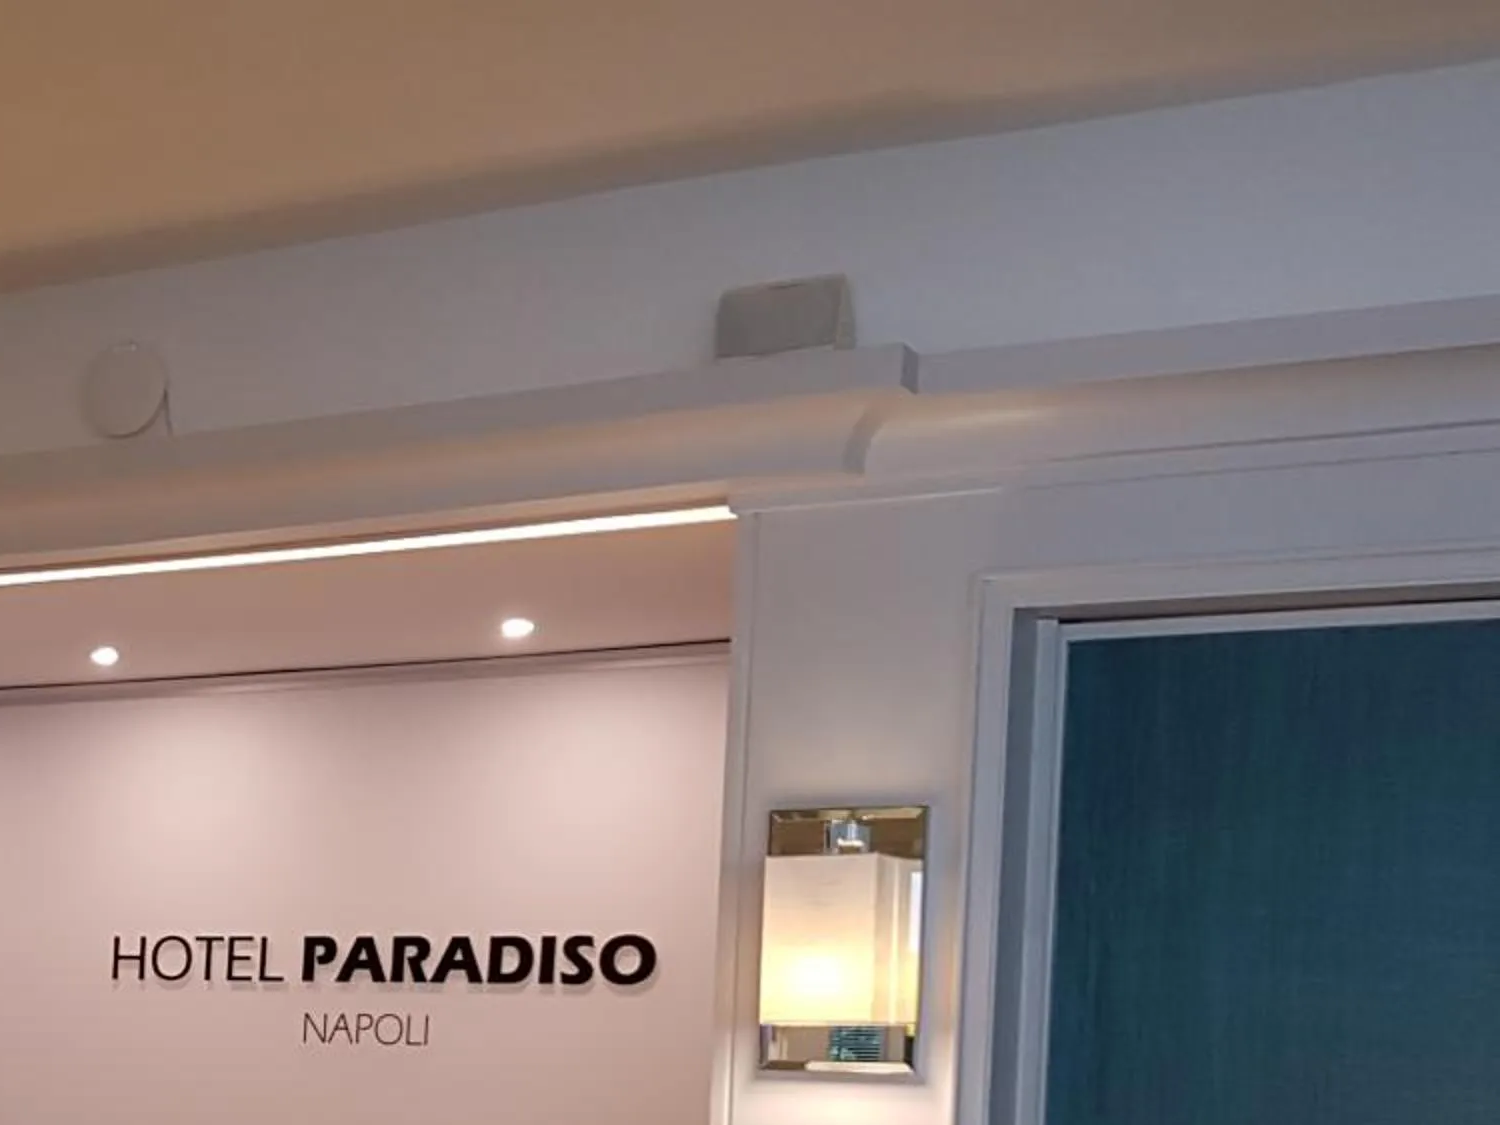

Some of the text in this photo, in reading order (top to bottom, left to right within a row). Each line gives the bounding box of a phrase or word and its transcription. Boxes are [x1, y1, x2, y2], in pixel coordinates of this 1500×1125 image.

[111, 934, 657, 985] HOTEL PARADISO
[303, 1012, 429, 1046] NAPOLI
